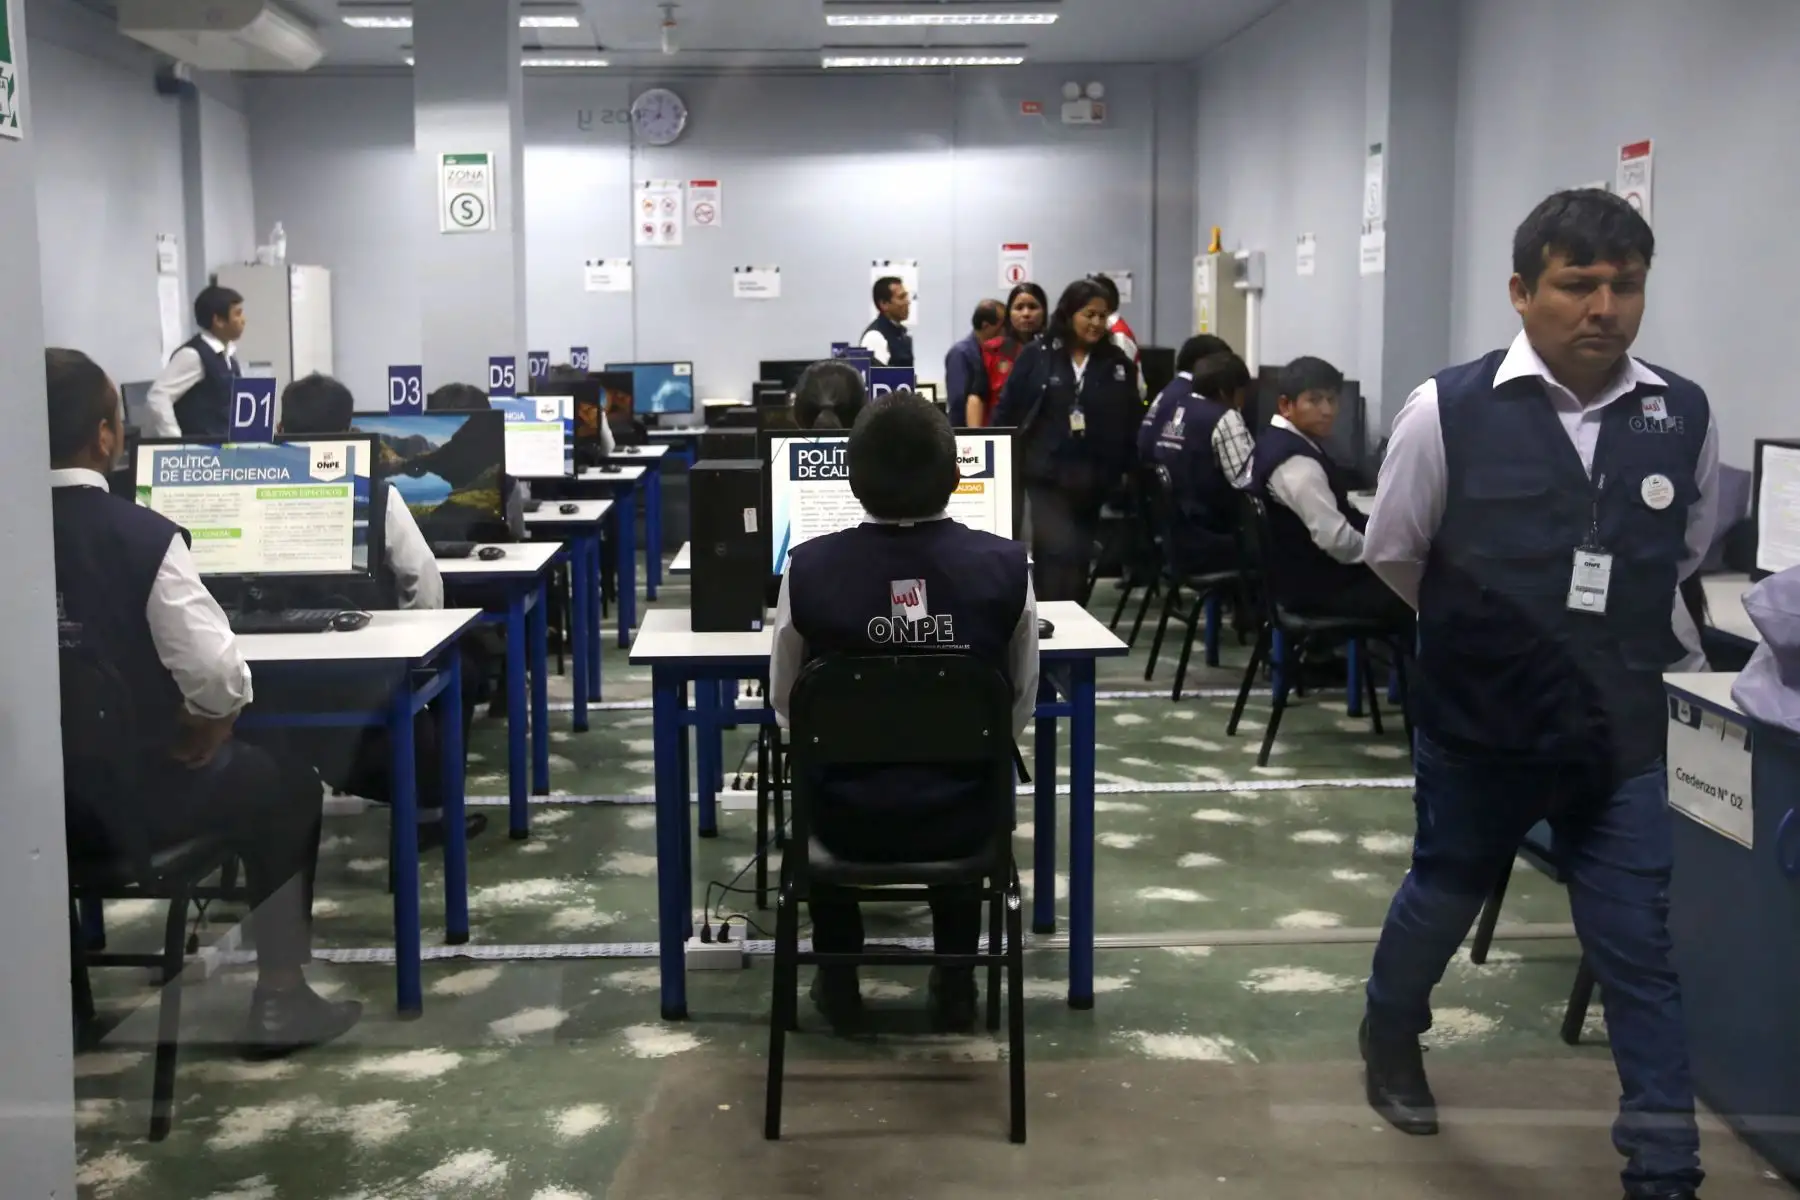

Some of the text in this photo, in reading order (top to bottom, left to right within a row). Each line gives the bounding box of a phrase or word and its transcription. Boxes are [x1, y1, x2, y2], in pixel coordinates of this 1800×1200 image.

[530, 358, 548, 376] D7
[572, 352, 588, 369] D9
[490, 365, 515, 388] D5
[390, 377, 421, 405] D3
[235, 392, 270, 427] D1
[1629, 415, 1684, 435] ONPE
[161, 454, 220, 469] POLÍTICA
[798, 446, 847, 464] POLÍT
[316, 461, 340, 469] ONPE
[798, 465, 849, 478] DE CALI
[160, 467, 290, 482] DE ECOEFICIENCIA
[867, 614, 954, 643] ONPE
[1675, 767, 1716, 797] Credenza
[1730, 793, 1743, 811] 02
